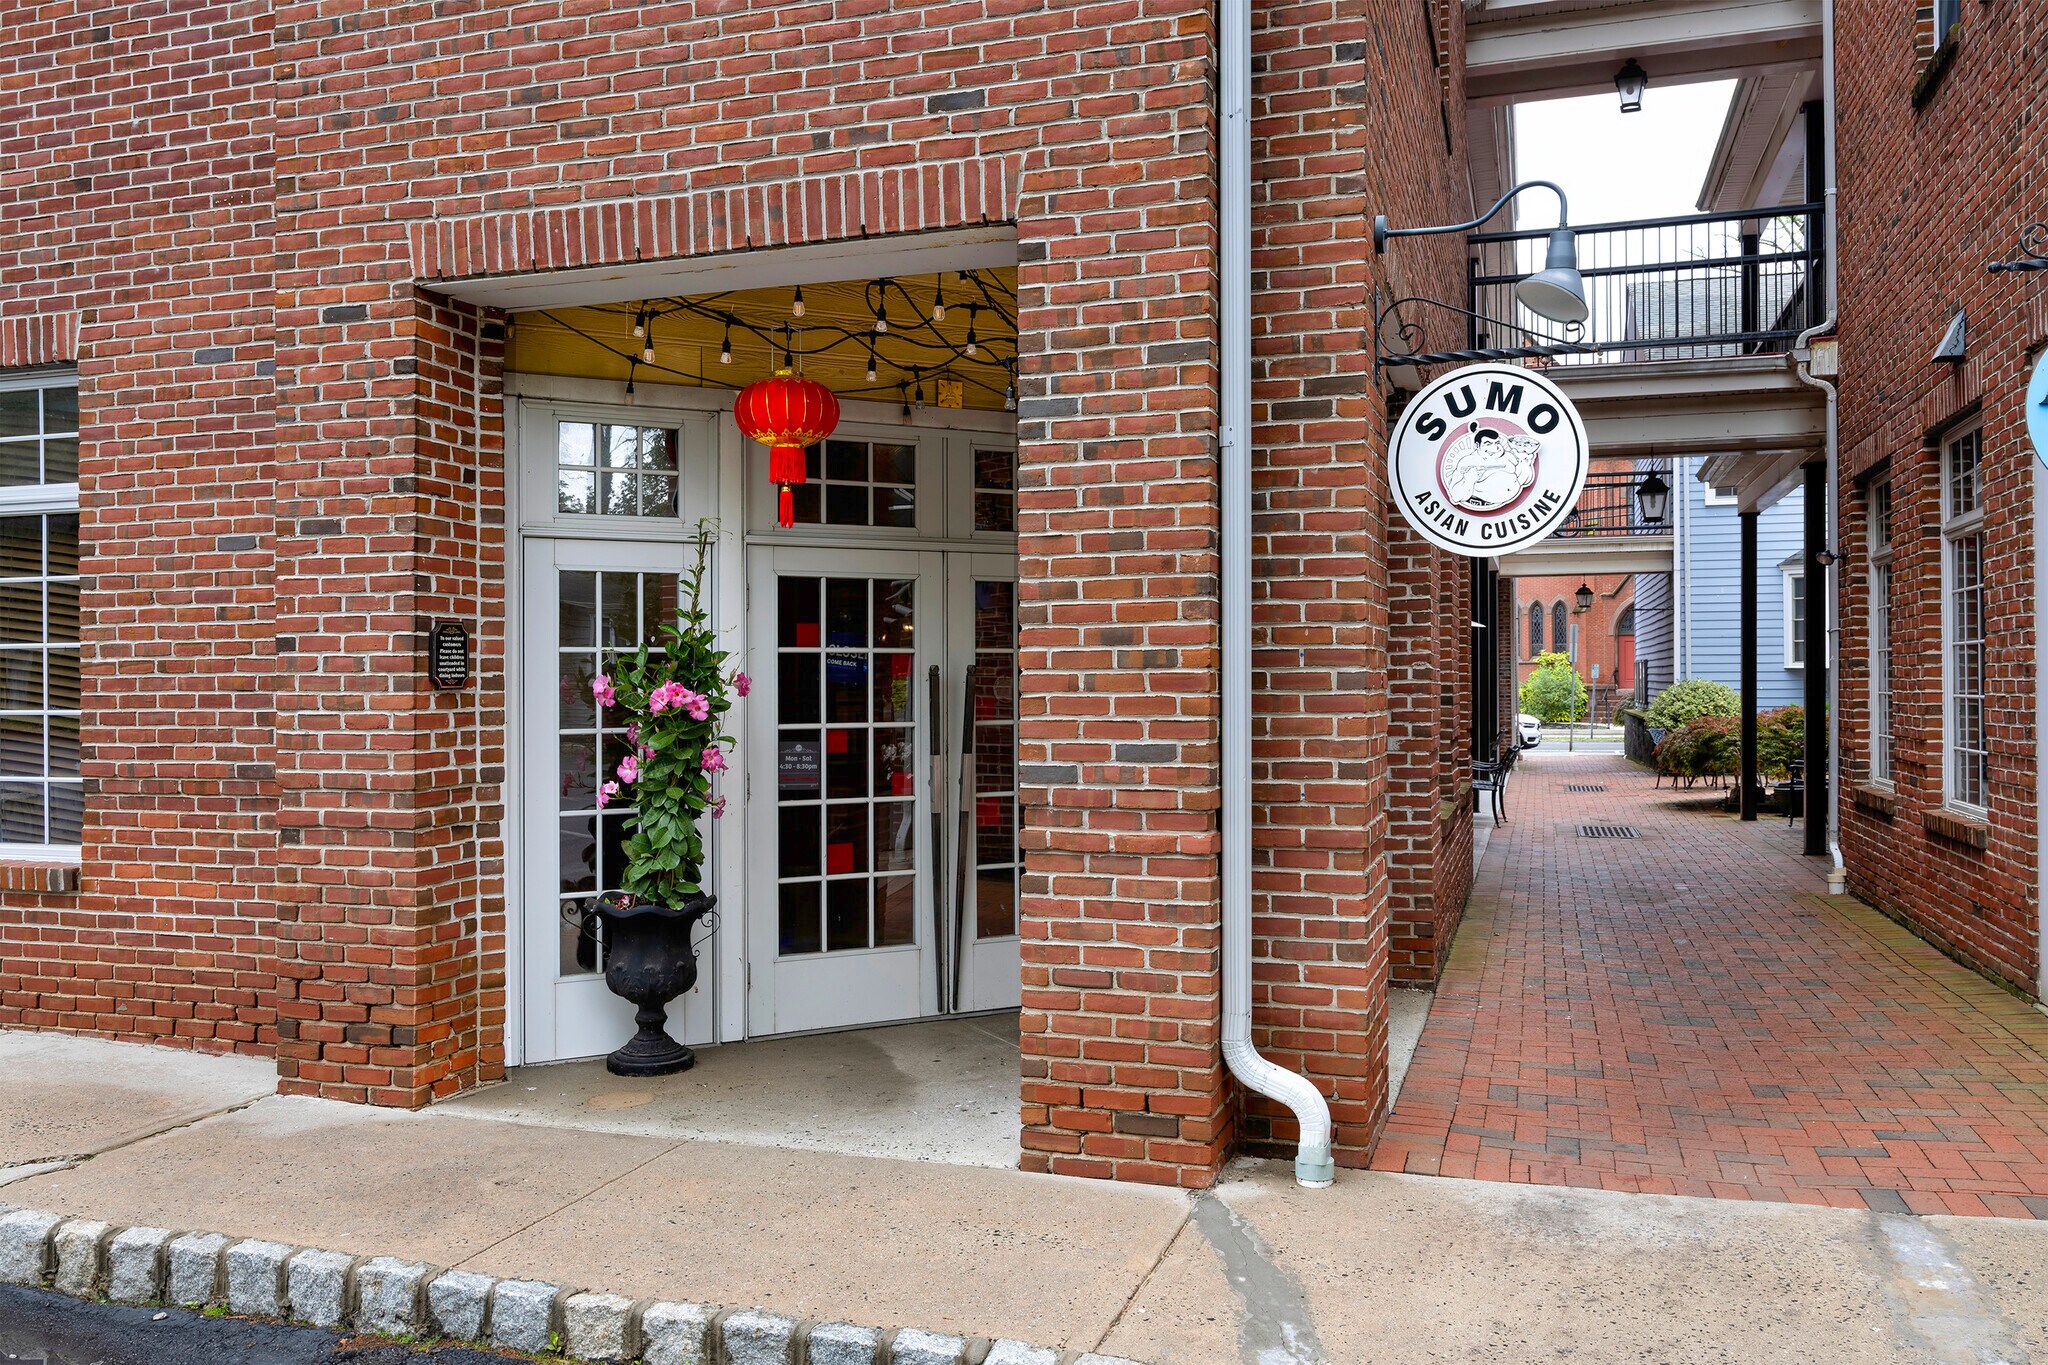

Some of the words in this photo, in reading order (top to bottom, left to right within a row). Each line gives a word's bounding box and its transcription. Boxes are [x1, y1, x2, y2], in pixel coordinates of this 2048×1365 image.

[1415, 381, 1559, 441] SUMO
[1415, 490, 1469, 536] ASIAN
[1481, 489, 1561, 540] CUISINE
